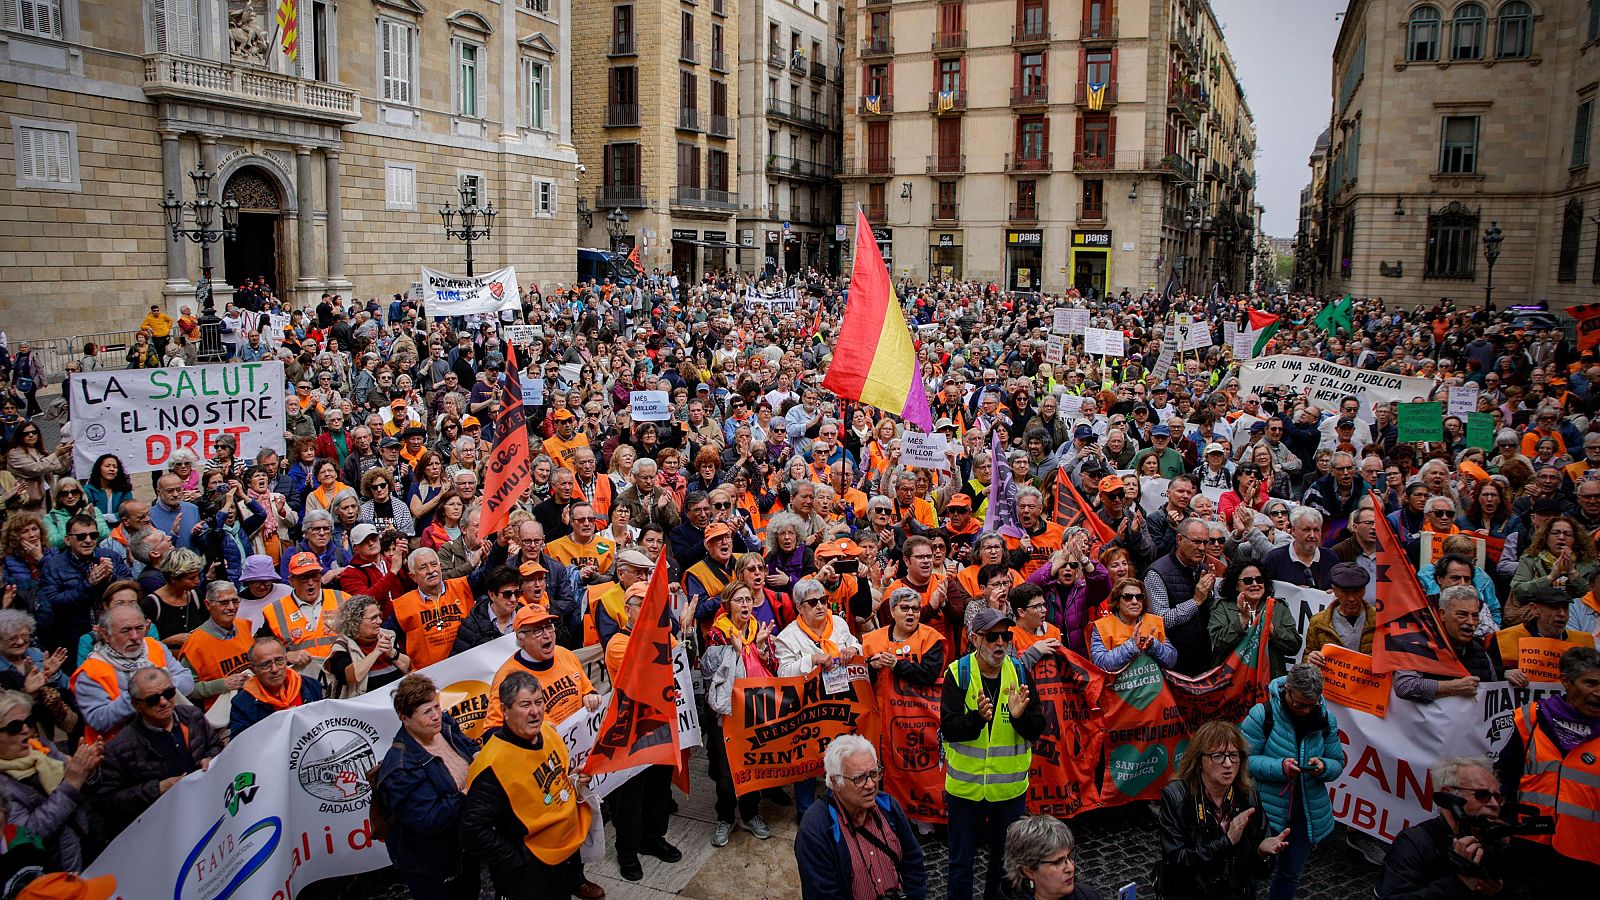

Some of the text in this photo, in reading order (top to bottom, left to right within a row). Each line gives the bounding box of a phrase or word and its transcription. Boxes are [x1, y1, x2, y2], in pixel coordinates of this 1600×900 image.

[217, 154, 233, 171] PALAU
[1018, 232, 1041, 243] pans
[1085, 233, 1109, 244] pans
[1254, 359, 1403, 390] POR UNA SANIDAD PUBLICA
[1290, 372, 1300, 383] Y
[1302, 373, 1318, 385] DE
[81, 363, 270, 405] LA SALUT,
[120, 396, 273, 434] EL NOSTRE
[145, 426, 251, 466] DRET
[907, 436, 924, 445] MÉS
[905, 447, 934, 457] MILLOR
[1521, 647, 1561, 659] POR UNA
[219, 652, 250, 677] MAR
[1521, 657, 1545, 667] 100%
[1337, 671, 1348, 679] DE
[760, 705, 847, 739] PENSIONISTA
[289, 717, 380, 771] MOVIMENT PENSIONISTA
[906, 728, 925, 748] SÍ
[743, 743, 807, 766] SANT
[903, 752, 931, 769] NO
[1115, 756, 1159, 771] SANIDAD
[318, 796, 372, 814] BADALON
